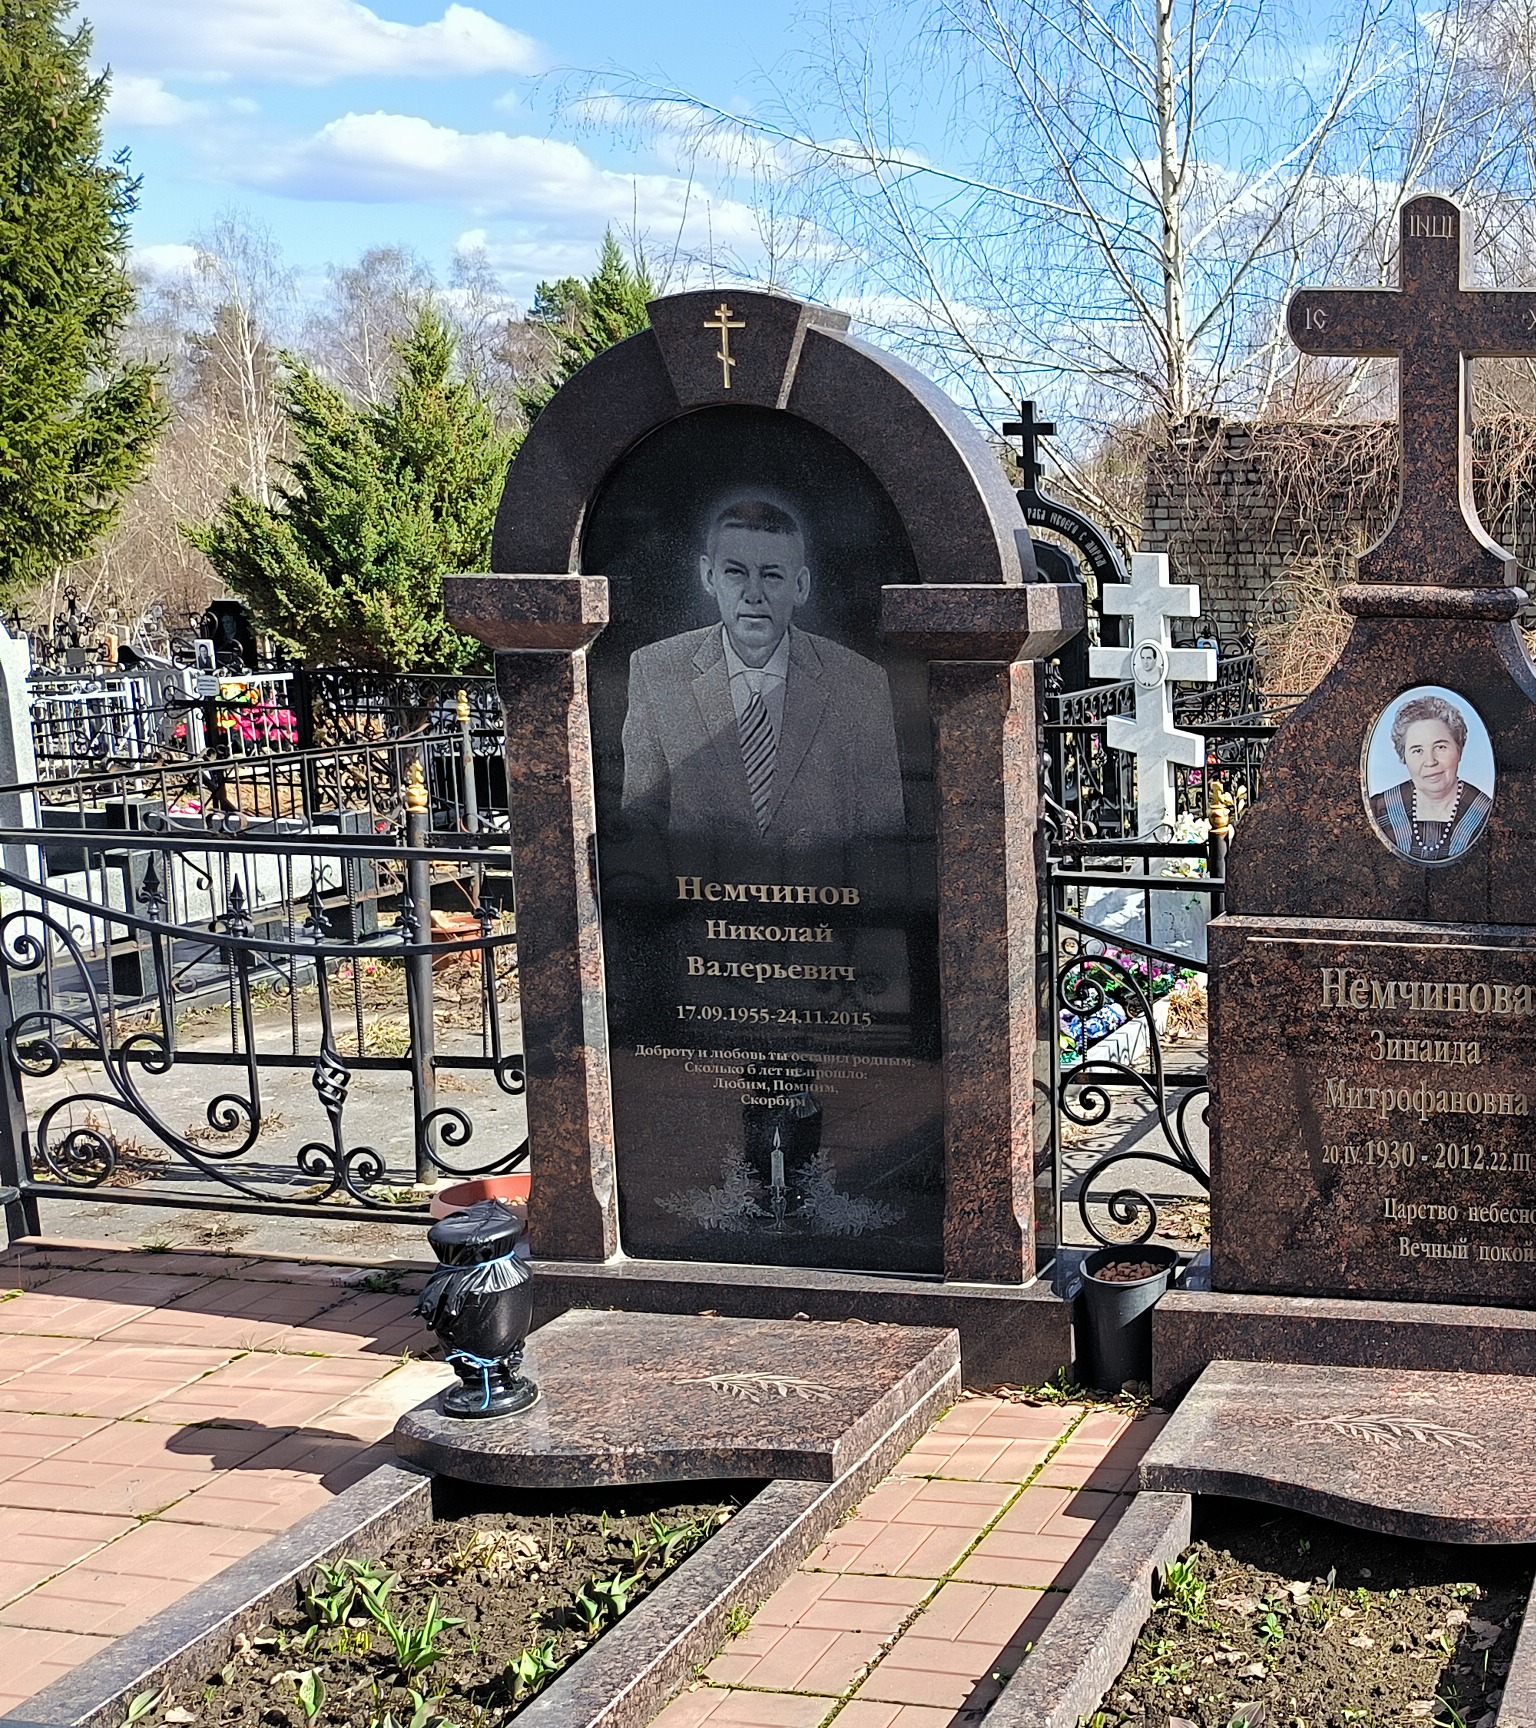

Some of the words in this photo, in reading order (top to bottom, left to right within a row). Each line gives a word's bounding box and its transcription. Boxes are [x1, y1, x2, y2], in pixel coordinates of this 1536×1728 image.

[676, 875, 861, 906] Немчинов
[706, 919, 834, 943] Николай
[687, 956, 857, 984] Валерьевич
[1320, 966, 1535, 1017] Немчинова
[676, 1004, 872, 1027] 17.09.1955-24.11.2015
[635, 1044, 695, 1061] Доброту
[698, 1049, 709, 1059] и
[711, 1048, 767, 1061] любовь
[768, 1051, 788, 1062] ты
[790, 1052, 849, 1065] оставил
[852, 1055, 917, 1070] родным,
[1370, 1029, 1482, 1067] Зинаида
[684, 1061, 744, 1075] Сколько
[758, 1065, 783, 1076] лет
[713, 1077, 771, 1092] Любим,
[773, 1080, 839, 1095] Помним,
[740, 1094, 806, 1109] Скорбим
[1324, 1077, 1530, 1122] Митрофановна
[1384, 1196, 1458, 1223] Царство
[1398, 1236, 1470, 1260] Вечный
[1479, 1238, 1536, 1262] покой
